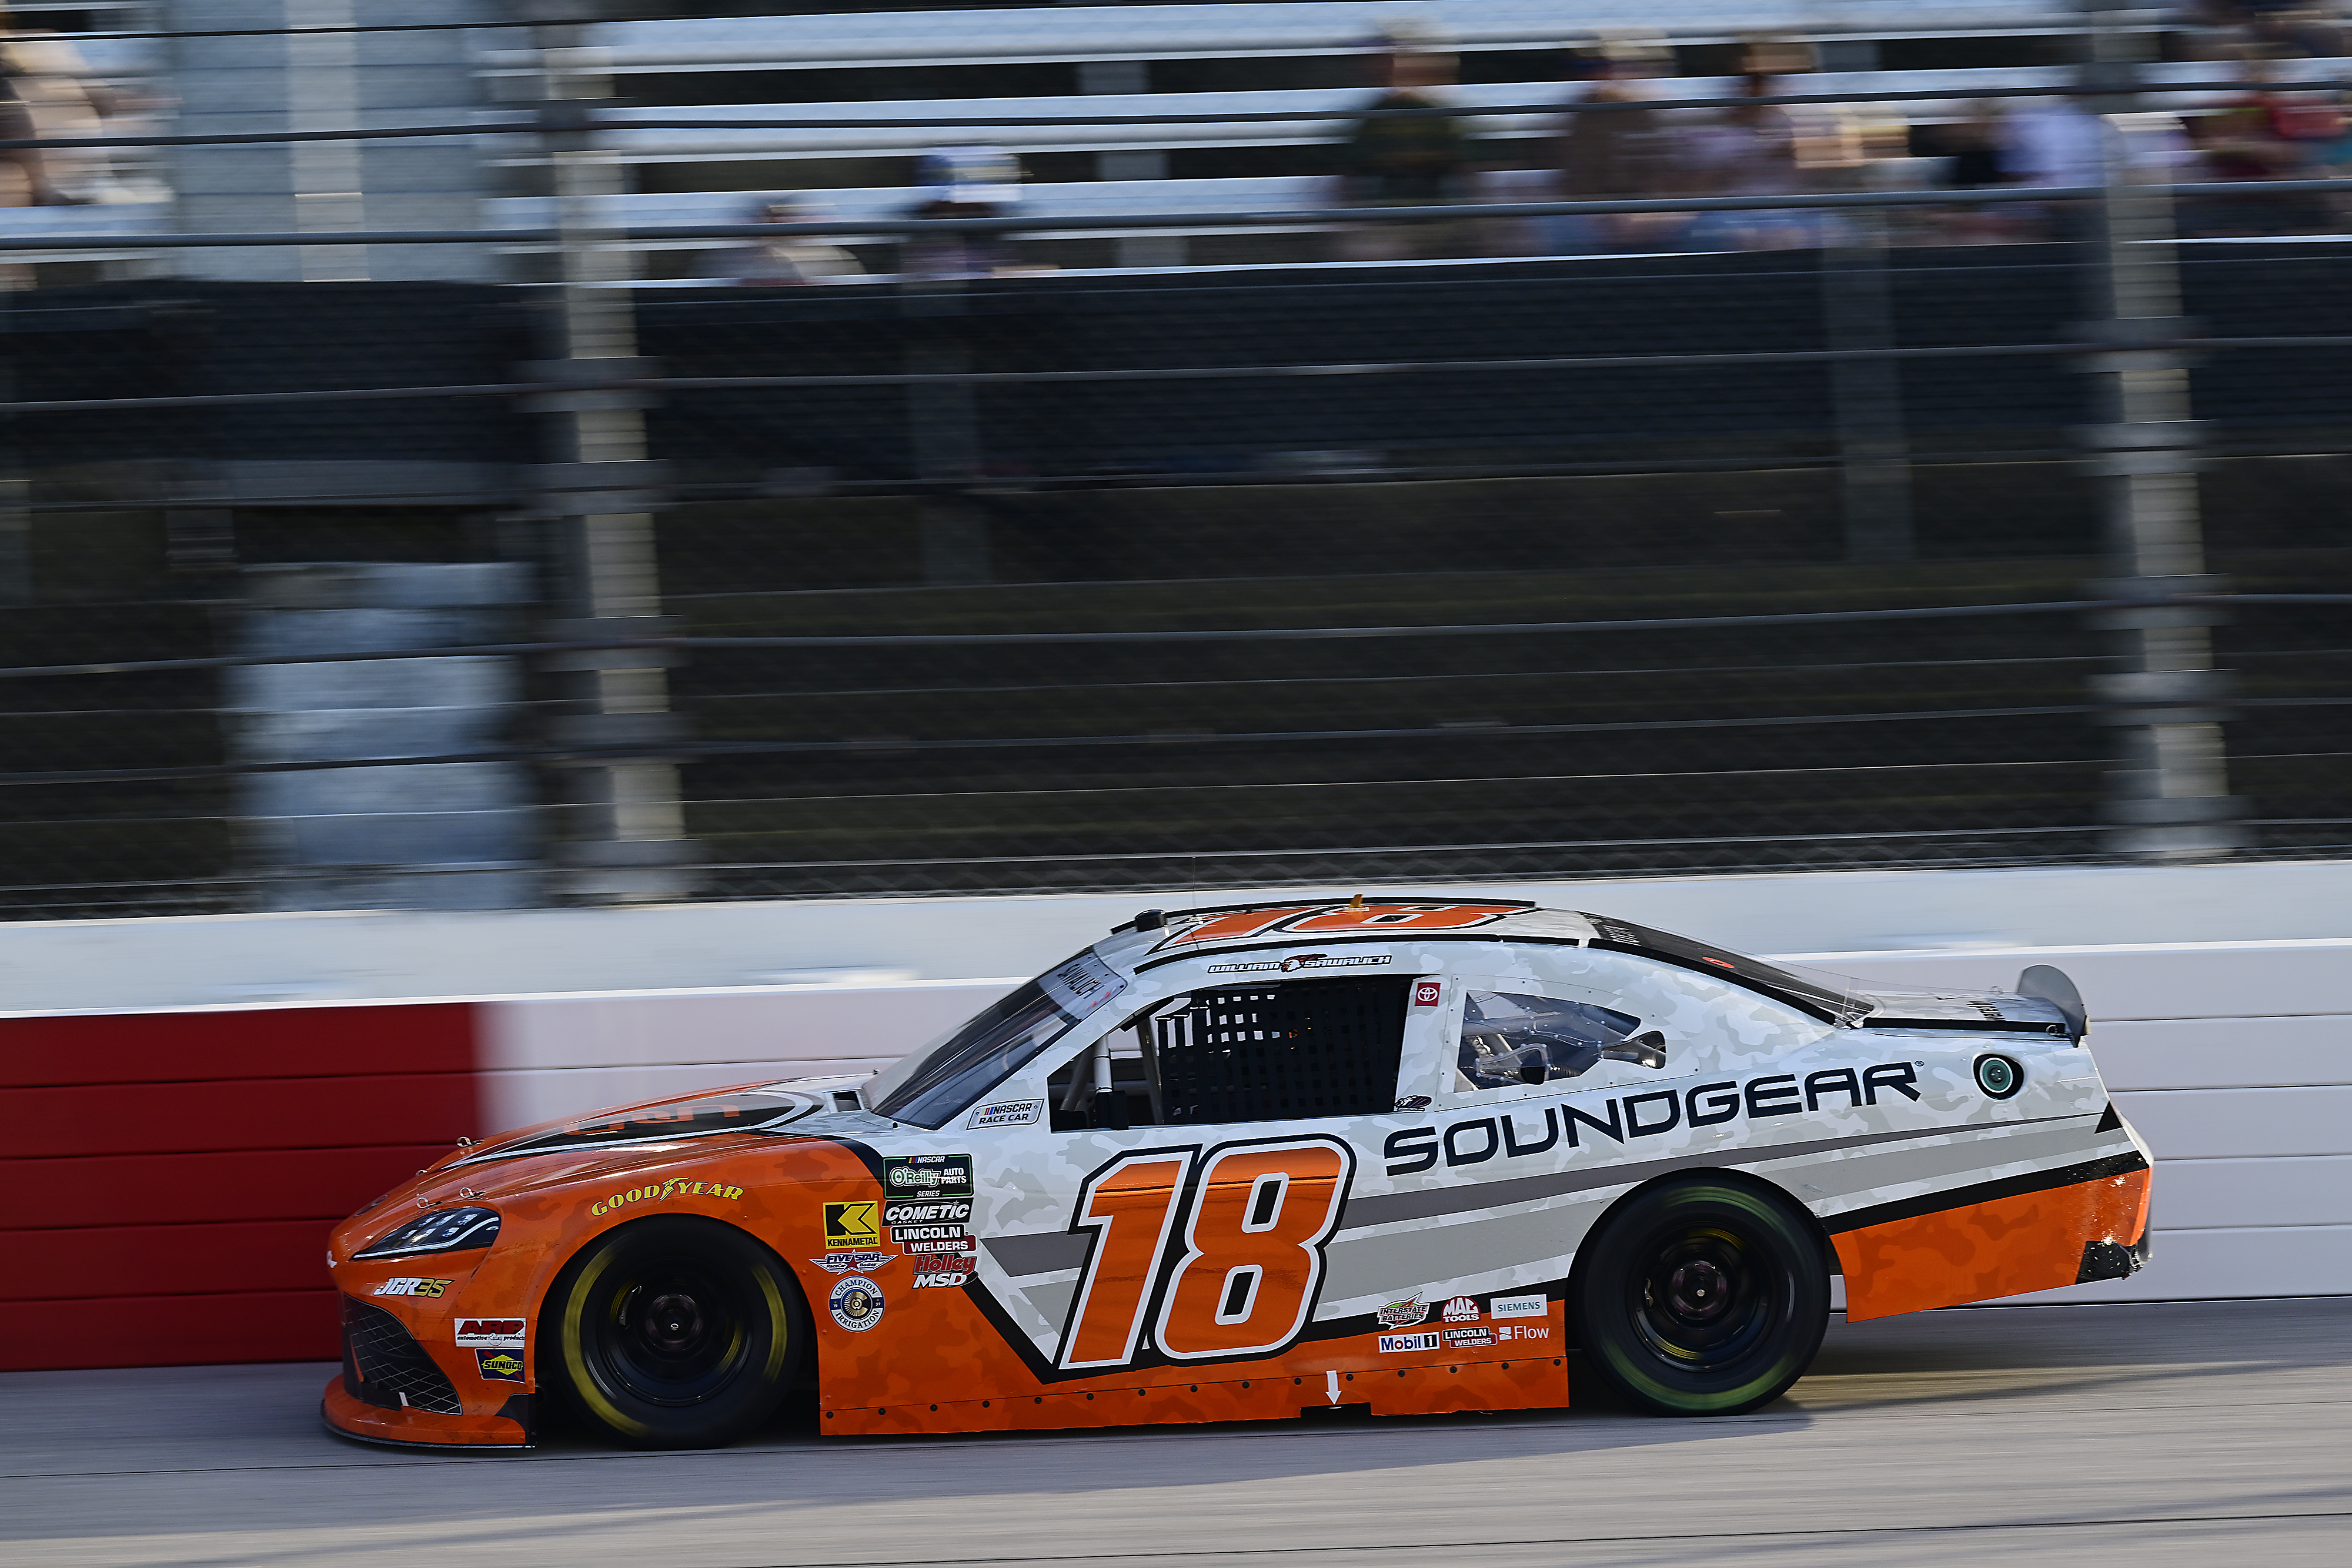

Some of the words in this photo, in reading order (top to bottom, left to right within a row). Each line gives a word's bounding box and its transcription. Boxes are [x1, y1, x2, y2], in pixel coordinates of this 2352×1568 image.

[1209, 962, 1279, 972] WILLIAM
[1303, 957, 1391, 968] SAWALICH
[1057, 964, 1105, 999] SAWALICH
[993, 1103, 1032, 1114] NASCAR
[978, 1115, 1005, 1124] RACE
[1384, 1062, 1922, 1176] SOUNDGEAR
[893, 1168, 939, 1185] O'Reilly
[886, 1204, 970, 1221] COMETIC
[895, 1226, 961, 1241] LINCOLN
[827, 1237, 878, 1246] KENNAMETAL
[910, 1241, 968, 1252] WELDERS
[827, 1255, 853, 1263] FIVE
[1058, 1136, 1354, 1369] 18
[914, 1254, 977, 1275] Holley
[835, 1279, 877, 1296] CHAMPION
[913, 1273, 967, 1288] MSD
[1381, 1306, 1426, 1315] INTERSTATE
[1443, 1297, 1479, 1316] MAC
[1498, 1301, 1541, 1312] SIEMENS
[835, 1310, 880, 1329] IRRIGATION
[1382, 1313, 1424, 1321] BATTERIES
[1443, 1314, 1479, 1323] TOOLS
[457, 1320, 524, 1335] ARP
[1445, 1329, 1487, 1339] LINCOLN
[1514, 1325, 1549, 1339] Flow
[1381, 1335, 1421, 1351] Mobil
[1454, 1338, 1492, 1346] WELDERS
[485, 1360, 524, 1370] SUNOCO
